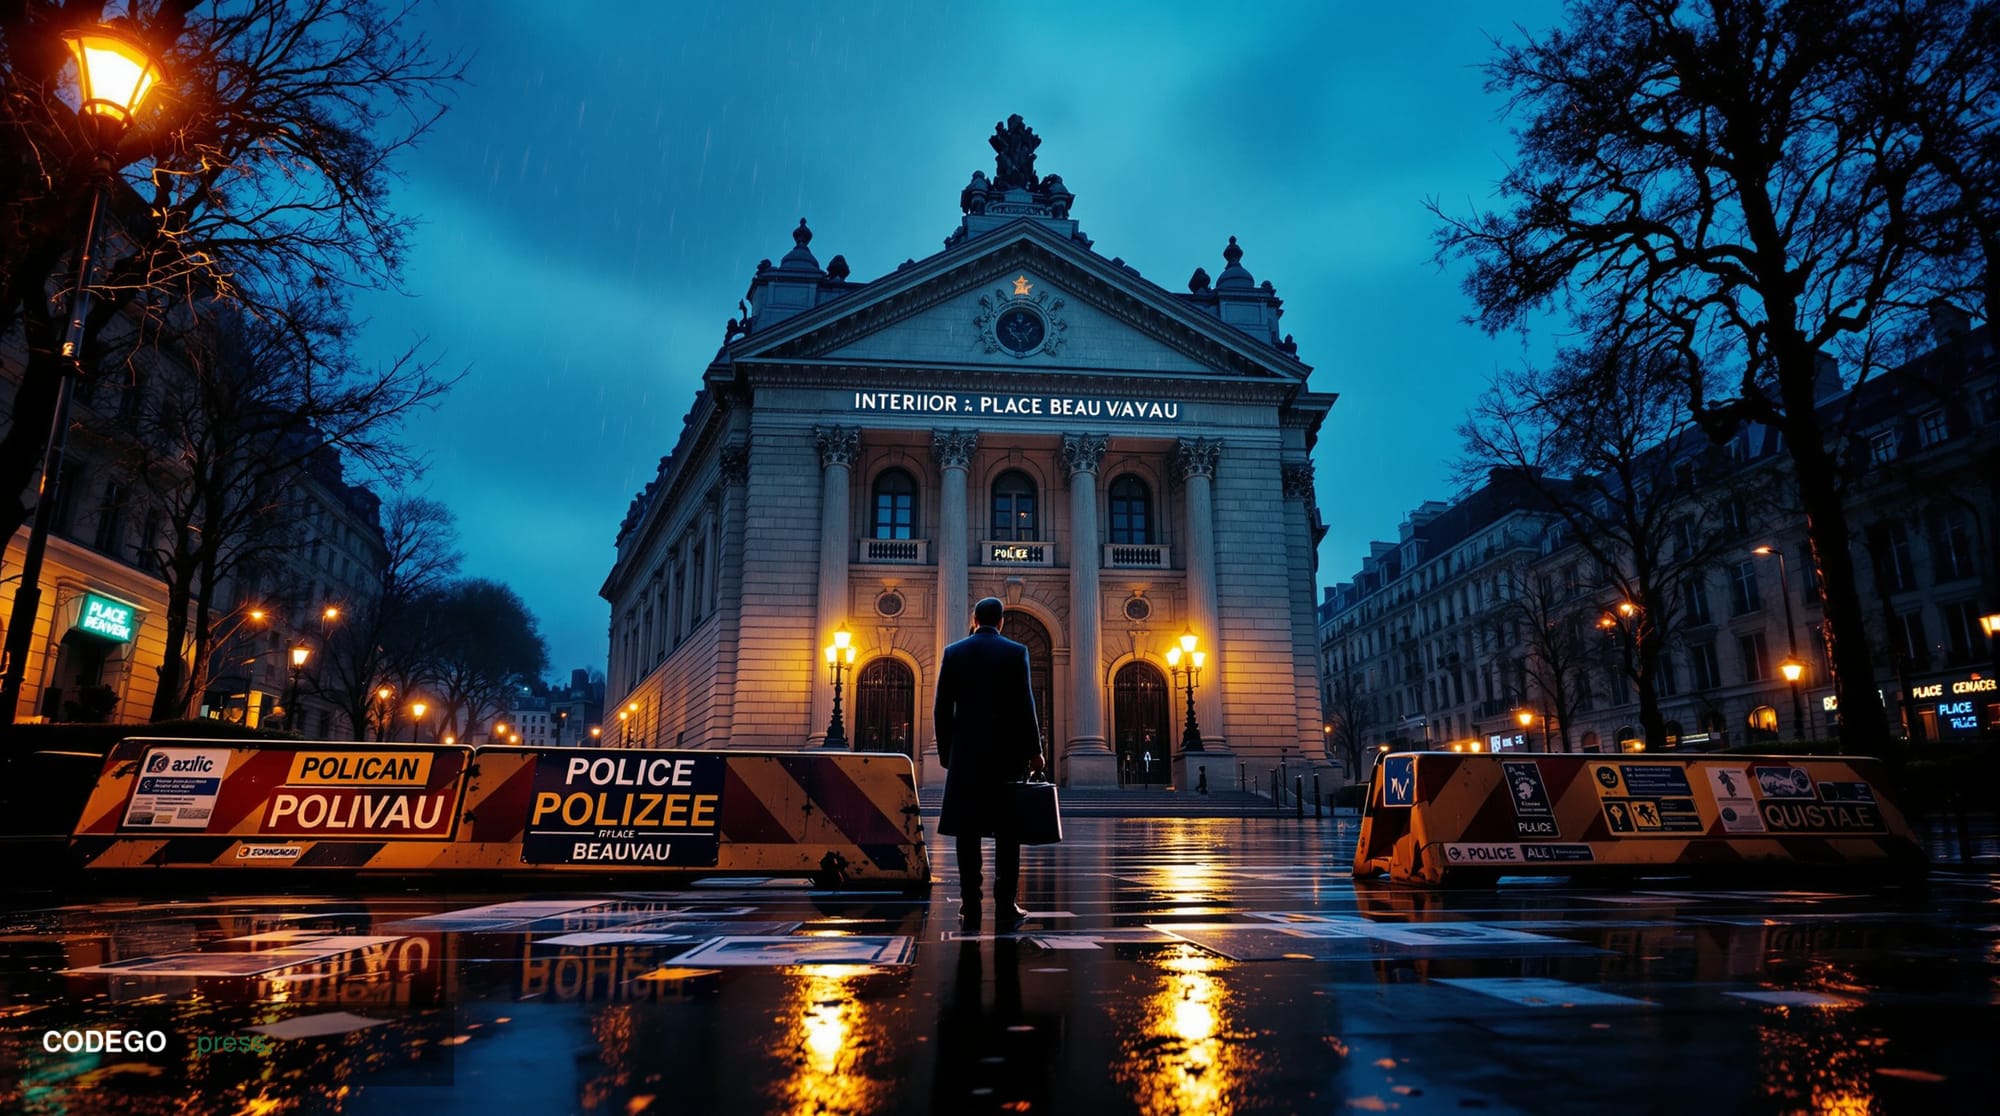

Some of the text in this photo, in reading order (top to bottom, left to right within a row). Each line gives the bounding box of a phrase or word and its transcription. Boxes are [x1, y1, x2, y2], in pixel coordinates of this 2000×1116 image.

[981, 396, 1042, 414] PLACE
[1050, 398, 1101, 416] BEAU
[88, 601, 128, 625] PLACE
[1912, 684, 1943, 699] PLACE
[1939, 701, 1973, 715] PLACE
[301, 757, 419, 780] POLICAN
[565, 757, 695, 786] POLICE
[268, 795, 444, 829] POLIVAU
[531, 792, 719, 827] POLIZEE
[572, 842, 671, 861] BEAUVAU
[1468, 847, 1516, 860] POLICE
